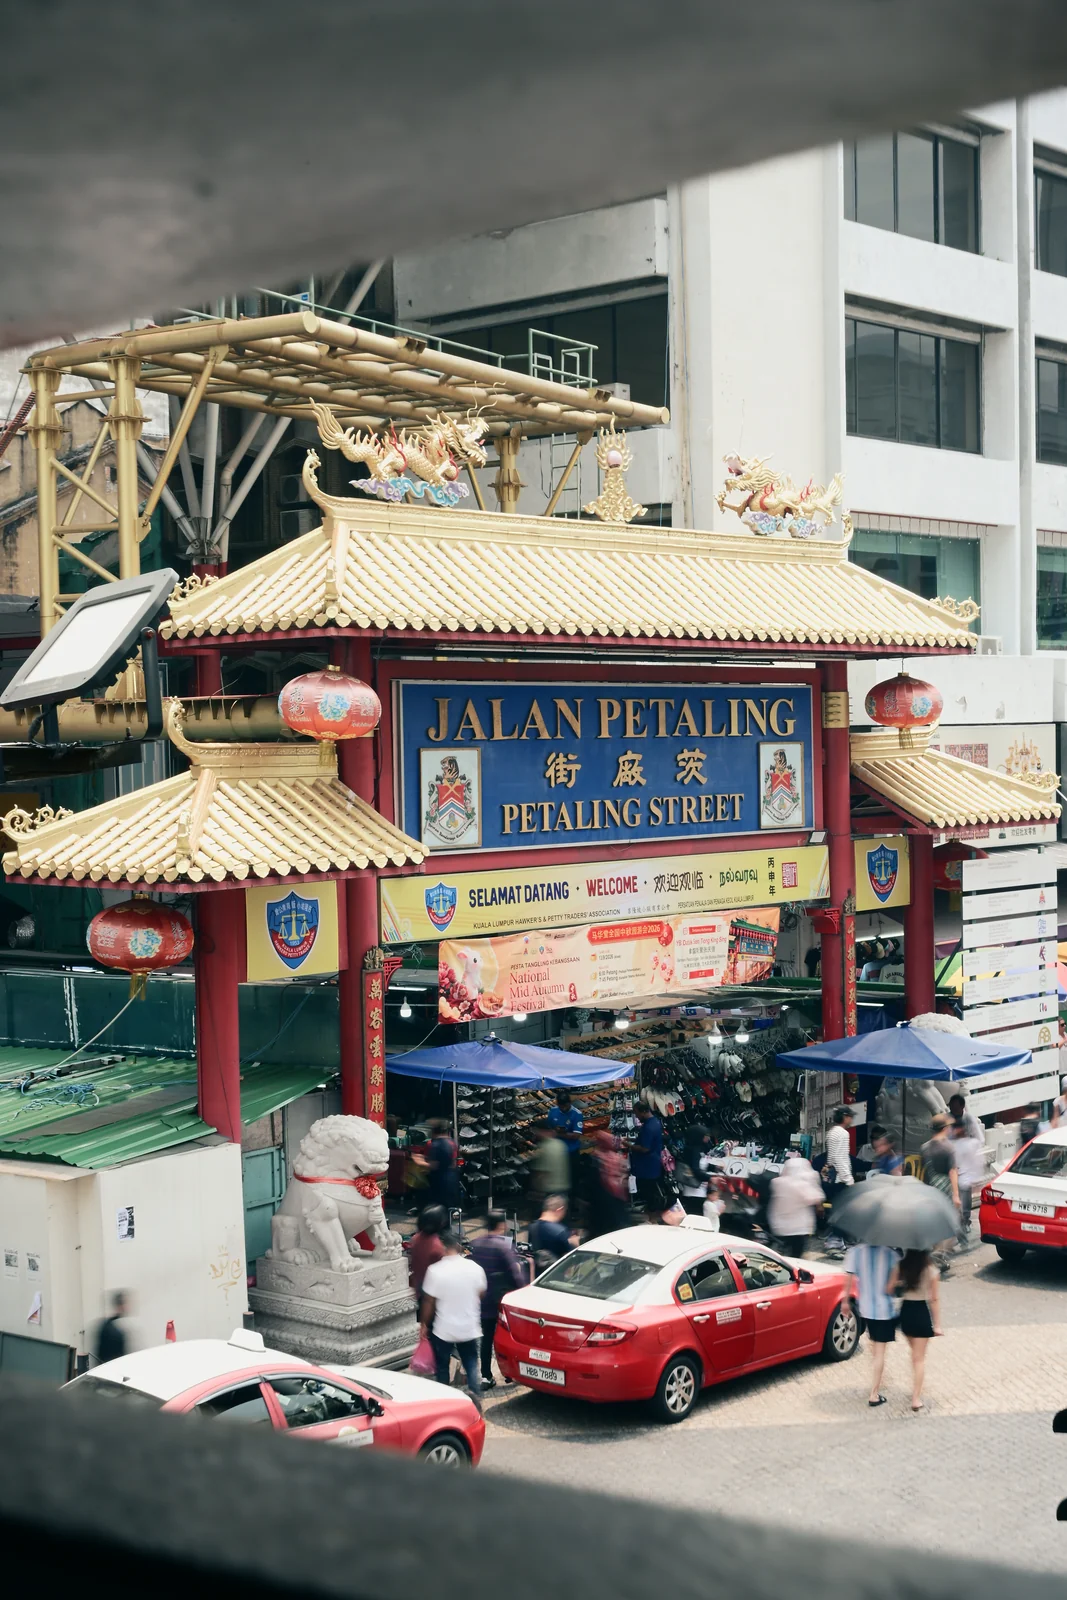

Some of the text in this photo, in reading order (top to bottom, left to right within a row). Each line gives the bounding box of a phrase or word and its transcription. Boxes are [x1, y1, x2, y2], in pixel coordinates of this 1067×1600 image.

[428, 697, 797, 742] JALAN PETALING
[502, 793, 745, 835] PETALING STREET
[468, 885, 521, 908] SELAMAT
[524, 881, 569, 904] DATANG
[586, 875, 638, 897] WELCOME
[492, 920, 514, 928] LUMPUR
[515, 917, 542, 925] HAWKER'S
[564, 912, 588, 920] TRADERS'
[588, 909, 621, 918] ASSOCIATION
[525, 960, 550, 969] TANGLUNG
[550, 957, 581, 966] KEBANGSAAN
[510, 968, 550, 985] National
[510, 983, 565, 1000] Mid Autumn
[510, 998, 546, 1012] Festival
[1032, 1205, 1048, 1214] 9718
[539, 1368, 558, 1381] 7889
